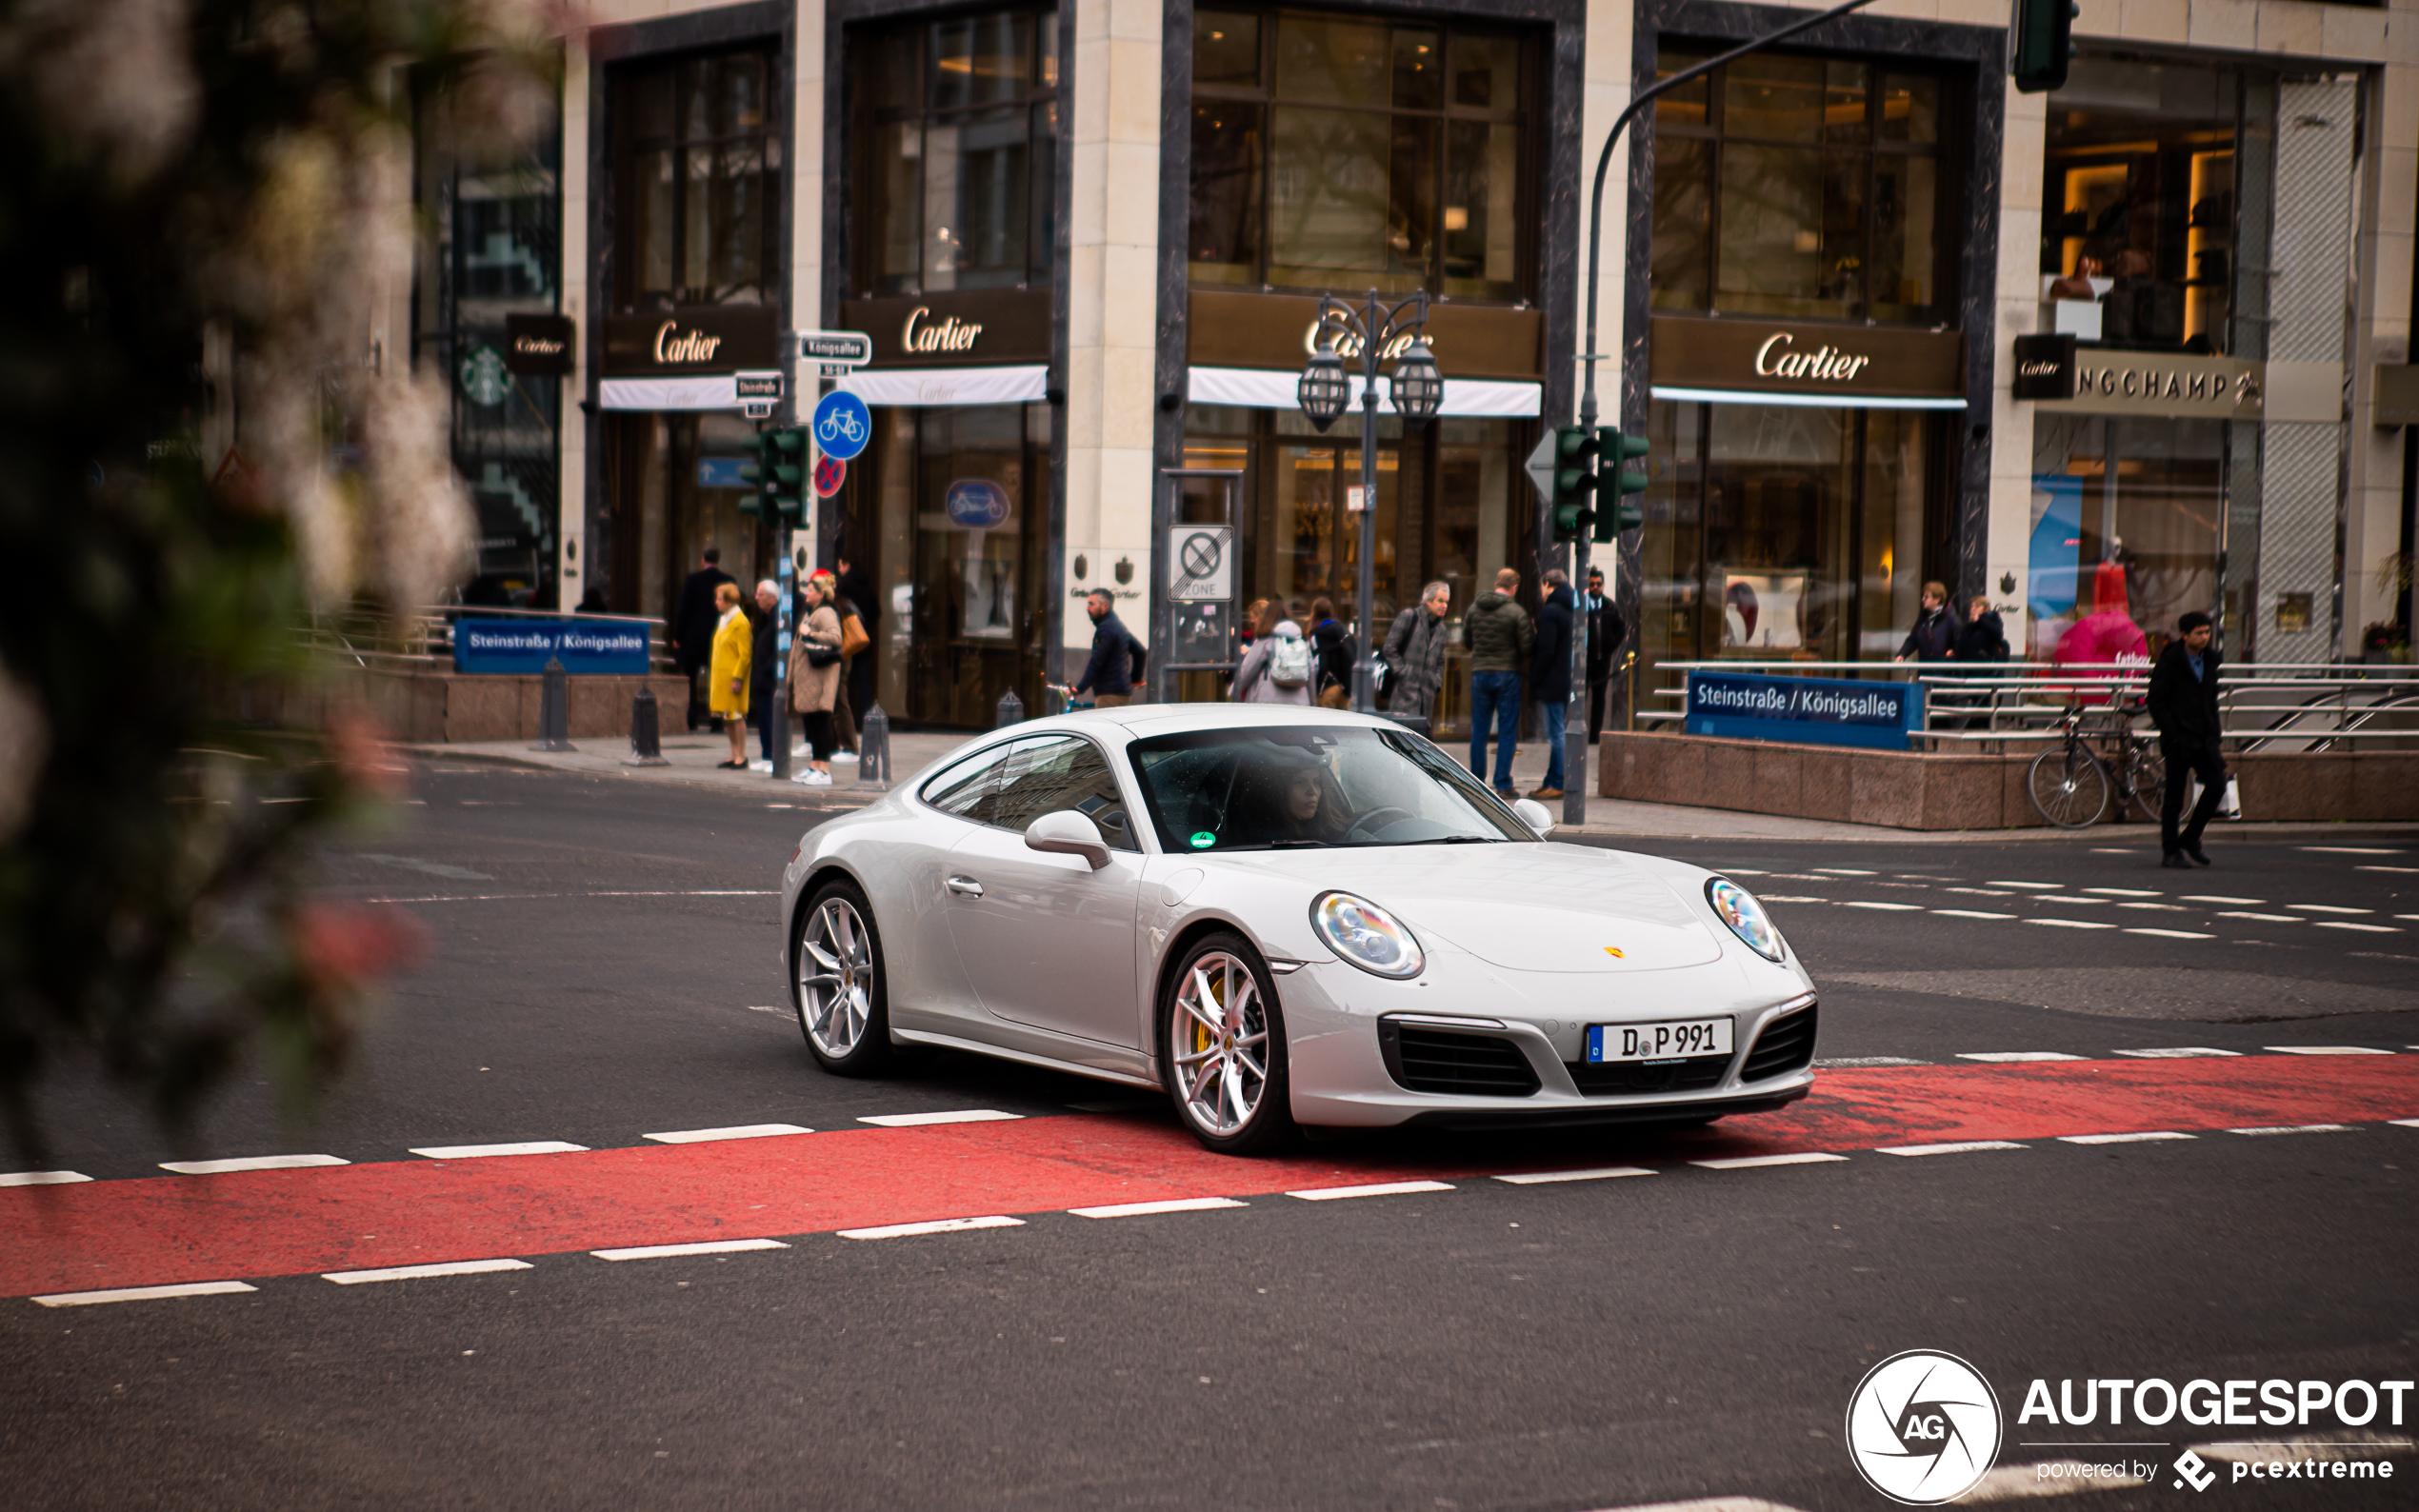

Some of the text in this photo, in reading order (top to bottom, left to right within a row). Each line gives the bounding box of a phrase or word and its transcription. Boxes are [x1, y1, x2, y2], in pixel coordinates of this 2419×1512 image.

[905, 307, 982, 352] Cartier
[515, 335, 565, 353] Cartier
[656, 320, 721, 363] Cartier
[809, 340, 861, 356] Königsallee
[1756, 331, 1869, 380] Cartier
[2021, 359, 2061, 376] Cartier
[739, 381, 776, 394] Steinstraße
[918, 379, 958, 401] Cartier
[1185, 584, 1216, 595] ZONE
[470, 631, 643, 651] Steinstraße / Königsallee
[1698, 684, 1897, 720] Steinstraße / Königsallee
[1200, 832, 1207, 841] 4
[1622, 1024, 1715, 1056] D P 991
